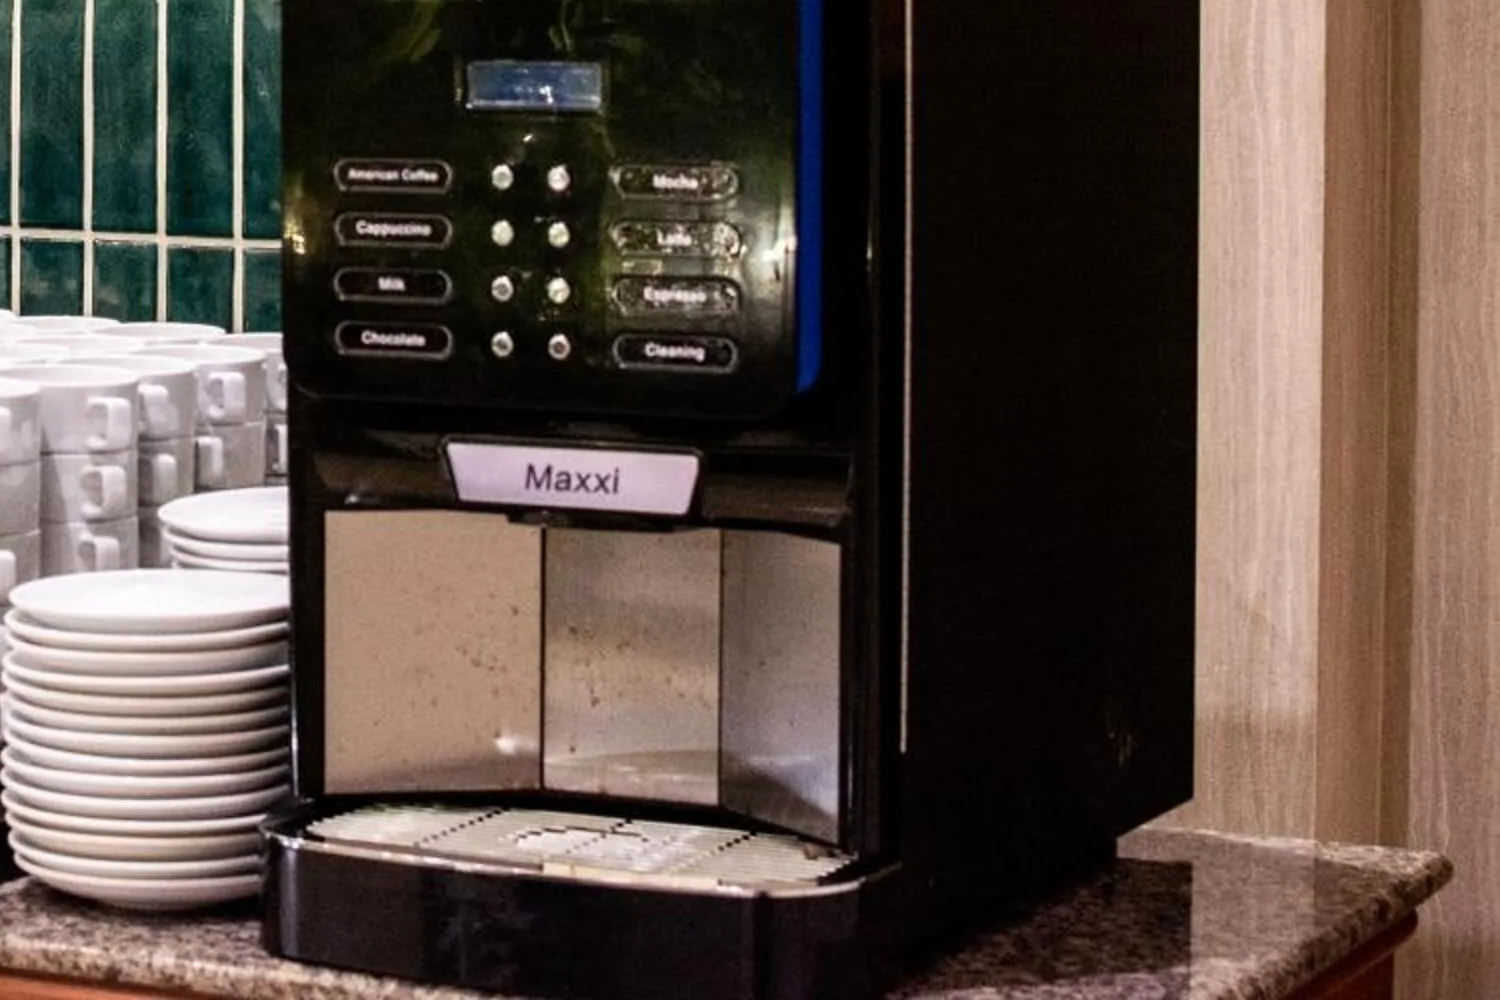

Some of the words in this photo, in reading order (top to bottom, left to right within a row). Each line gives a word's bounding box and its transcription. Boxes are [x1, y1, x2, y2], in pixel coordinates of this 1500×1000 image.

[401, 168, 438, 182] Coffee
[355, 219, 432, 237] Cappuccino
[361, 329, 426, 347] Chocolate
[645, 341, 706, 362] Cleaning
[524, 463, 619, 494] Maxxi
